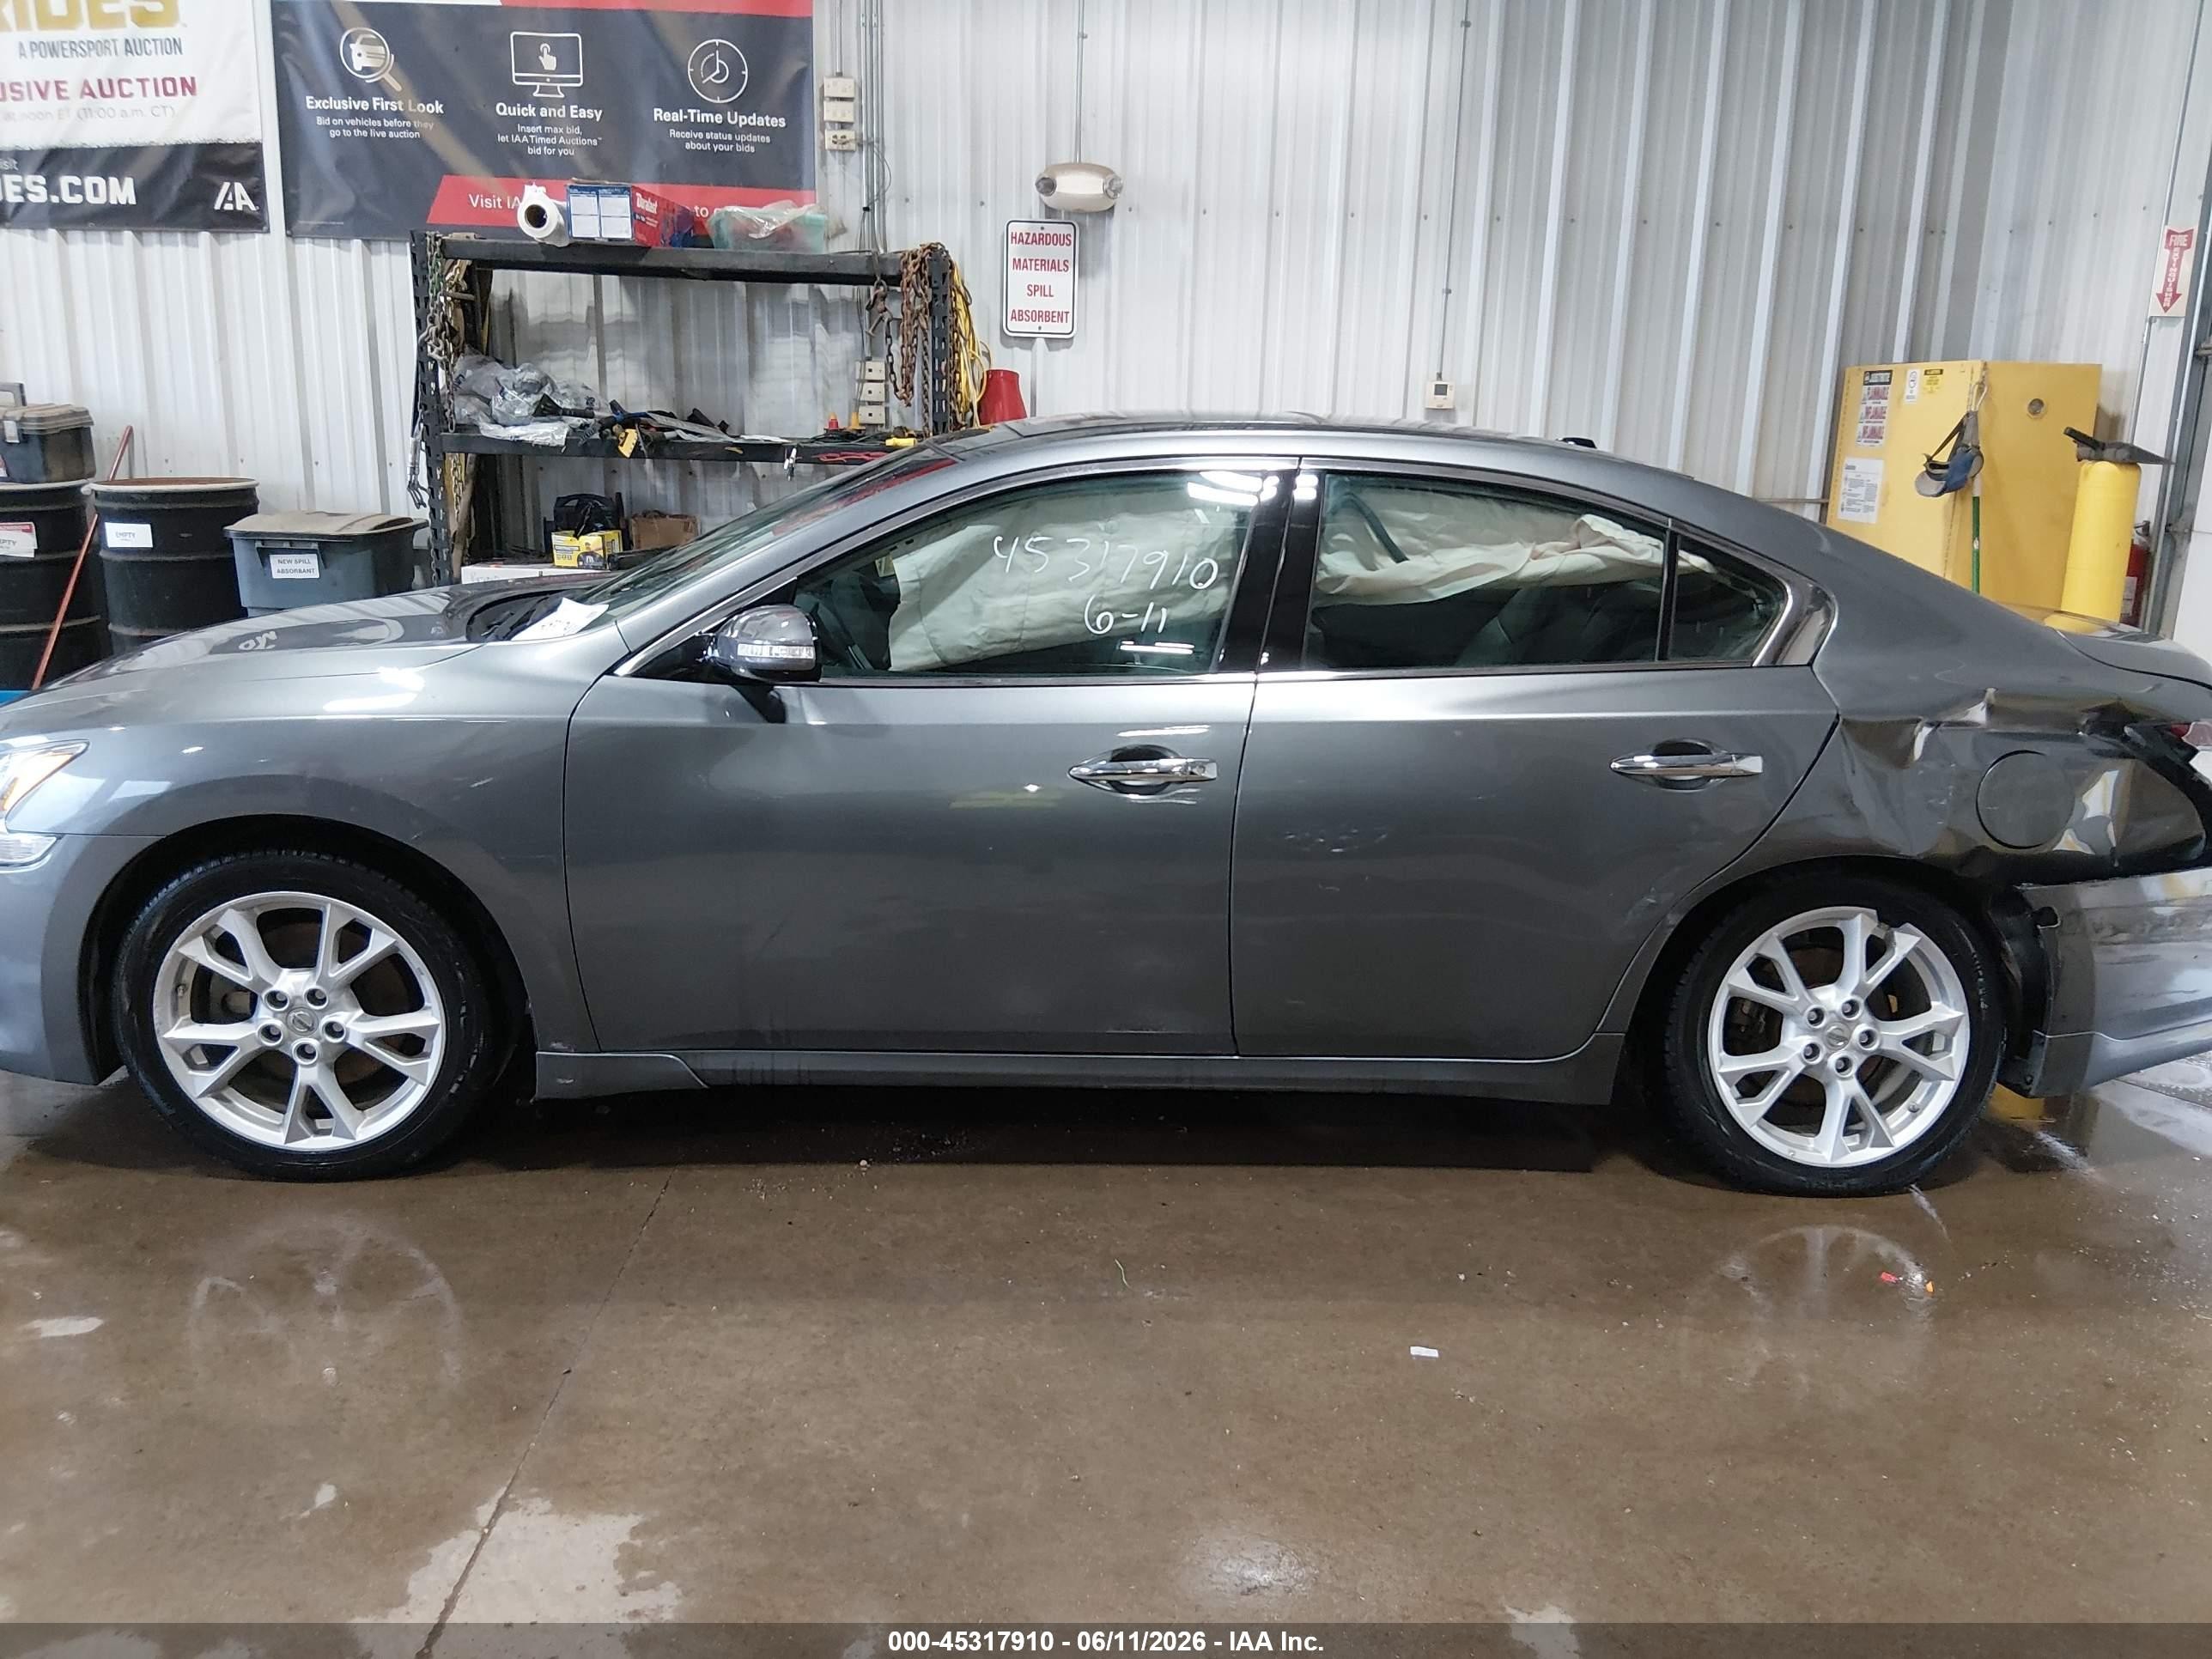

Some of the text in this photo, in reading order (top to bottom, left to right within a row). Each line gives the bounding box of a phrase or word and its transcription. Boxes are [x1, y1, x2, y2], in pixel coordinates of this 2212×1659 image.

[18, 36, 184, 59] A POWERSPORT AUCTION
[80, 76, 198, 100] AUCTION
[306, 95, 444, 114] Exclusive First Look
[495, 102, 603, 122] Quick and Easy
[653, 108, 786, 128] Real-Time Updates
[316, 116, 330, 126] Bid
[345, 117, 381, 127] vehicles
[384, 118, 411, 128] before
[413, 119, 434, 131] they
[517, 124, 542, 133] Insert
[330, 130, 341, 138] go
[353, 129, 368, 137] the
[370, 129, 386, 137] live
[388, 130, 420, 138] auction
[497, 134, 509, 143] let
[669, 129, 770, 143] Receive status updates
[528, 146, 574, 156] bid for you
[685, 141, 755, 153] about your bids
[0, 174, 137, 205] ES.COM
[469, 193, 502, 209] Visit
[694, 205, 709, 217] to
[1011, 232, 1072, 246] HAZARDOUS
[2169, 234, 2189, 247] FIRE
[1012, 258, 1070, 273] MATERIALS
[1027, 284, 1054, 298] SPILL
[1010, 309, 1070, 324] ABSORBENT
